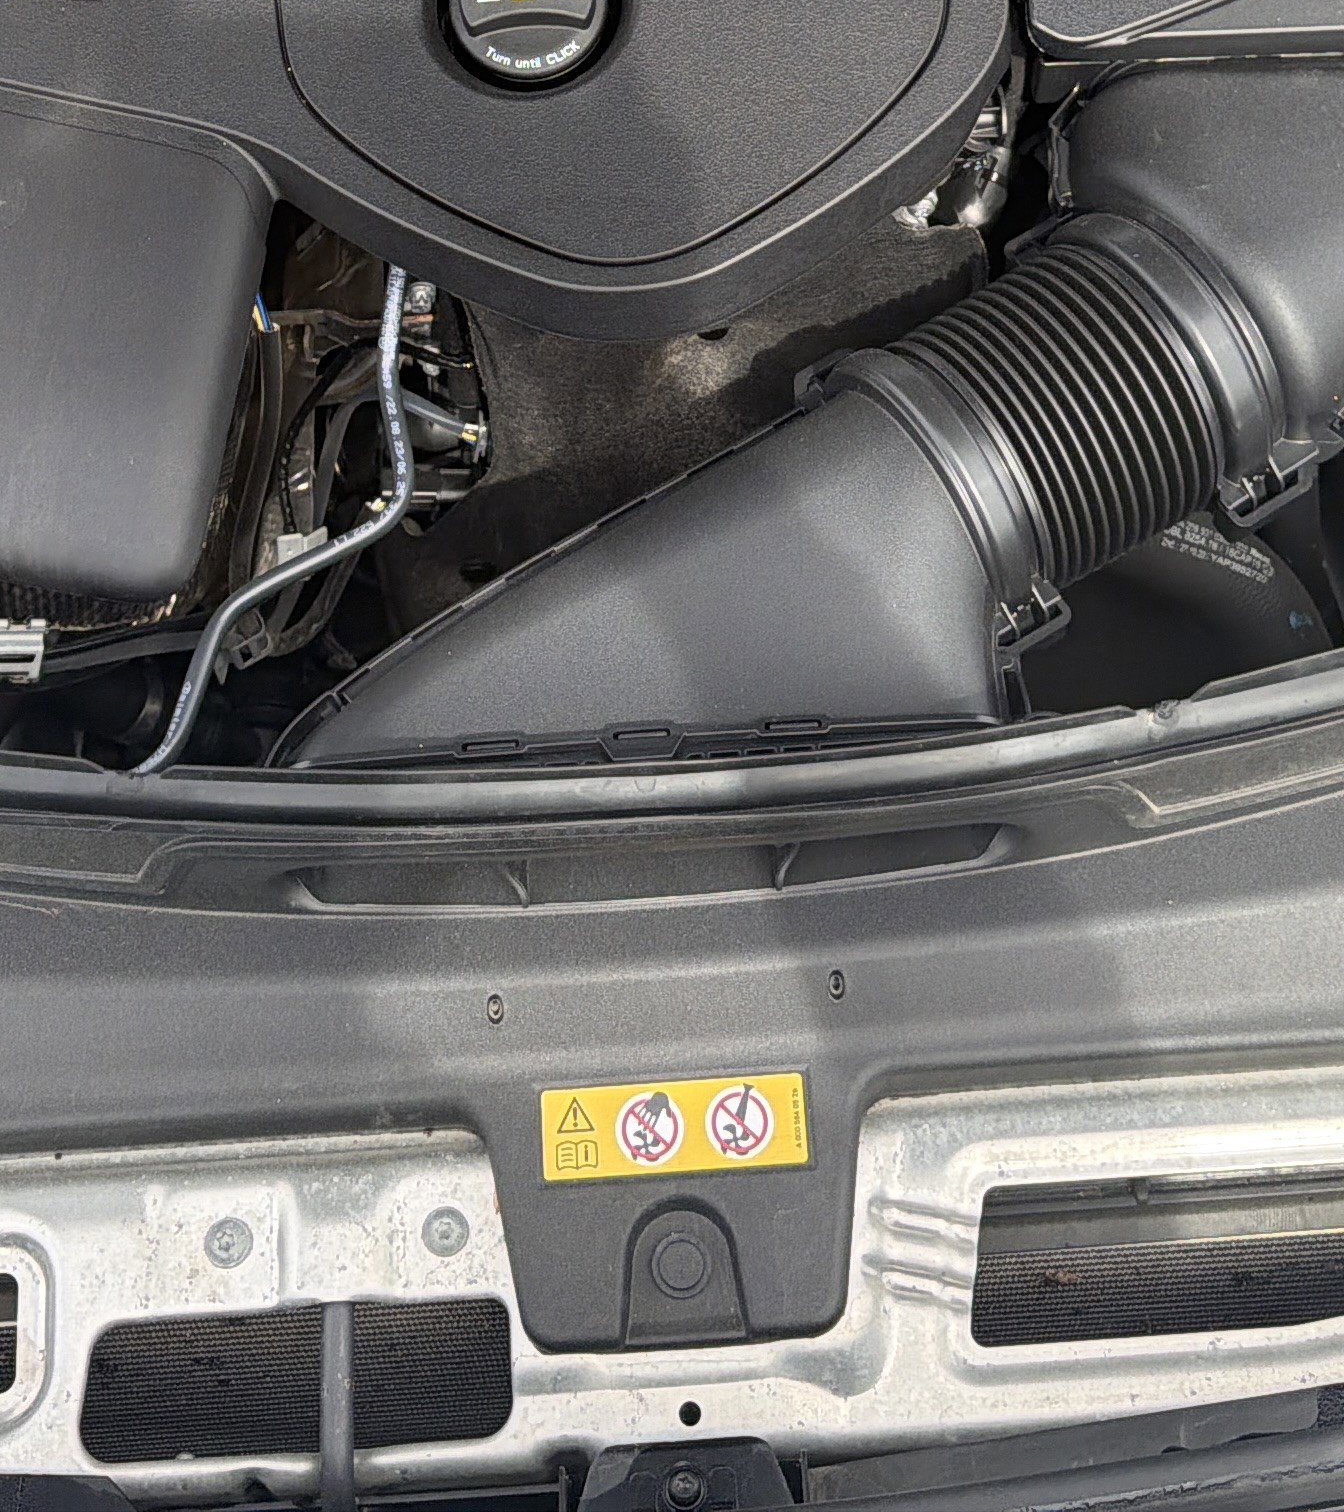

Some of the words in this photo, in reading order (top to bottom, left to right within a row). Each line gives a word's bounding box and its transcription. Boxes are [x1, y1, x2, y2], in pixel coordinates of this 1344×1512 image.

[485, 46, 510, 66] Turn
[515, 57, 541, 69] until
[546, 40, 581, 65] CLICK
